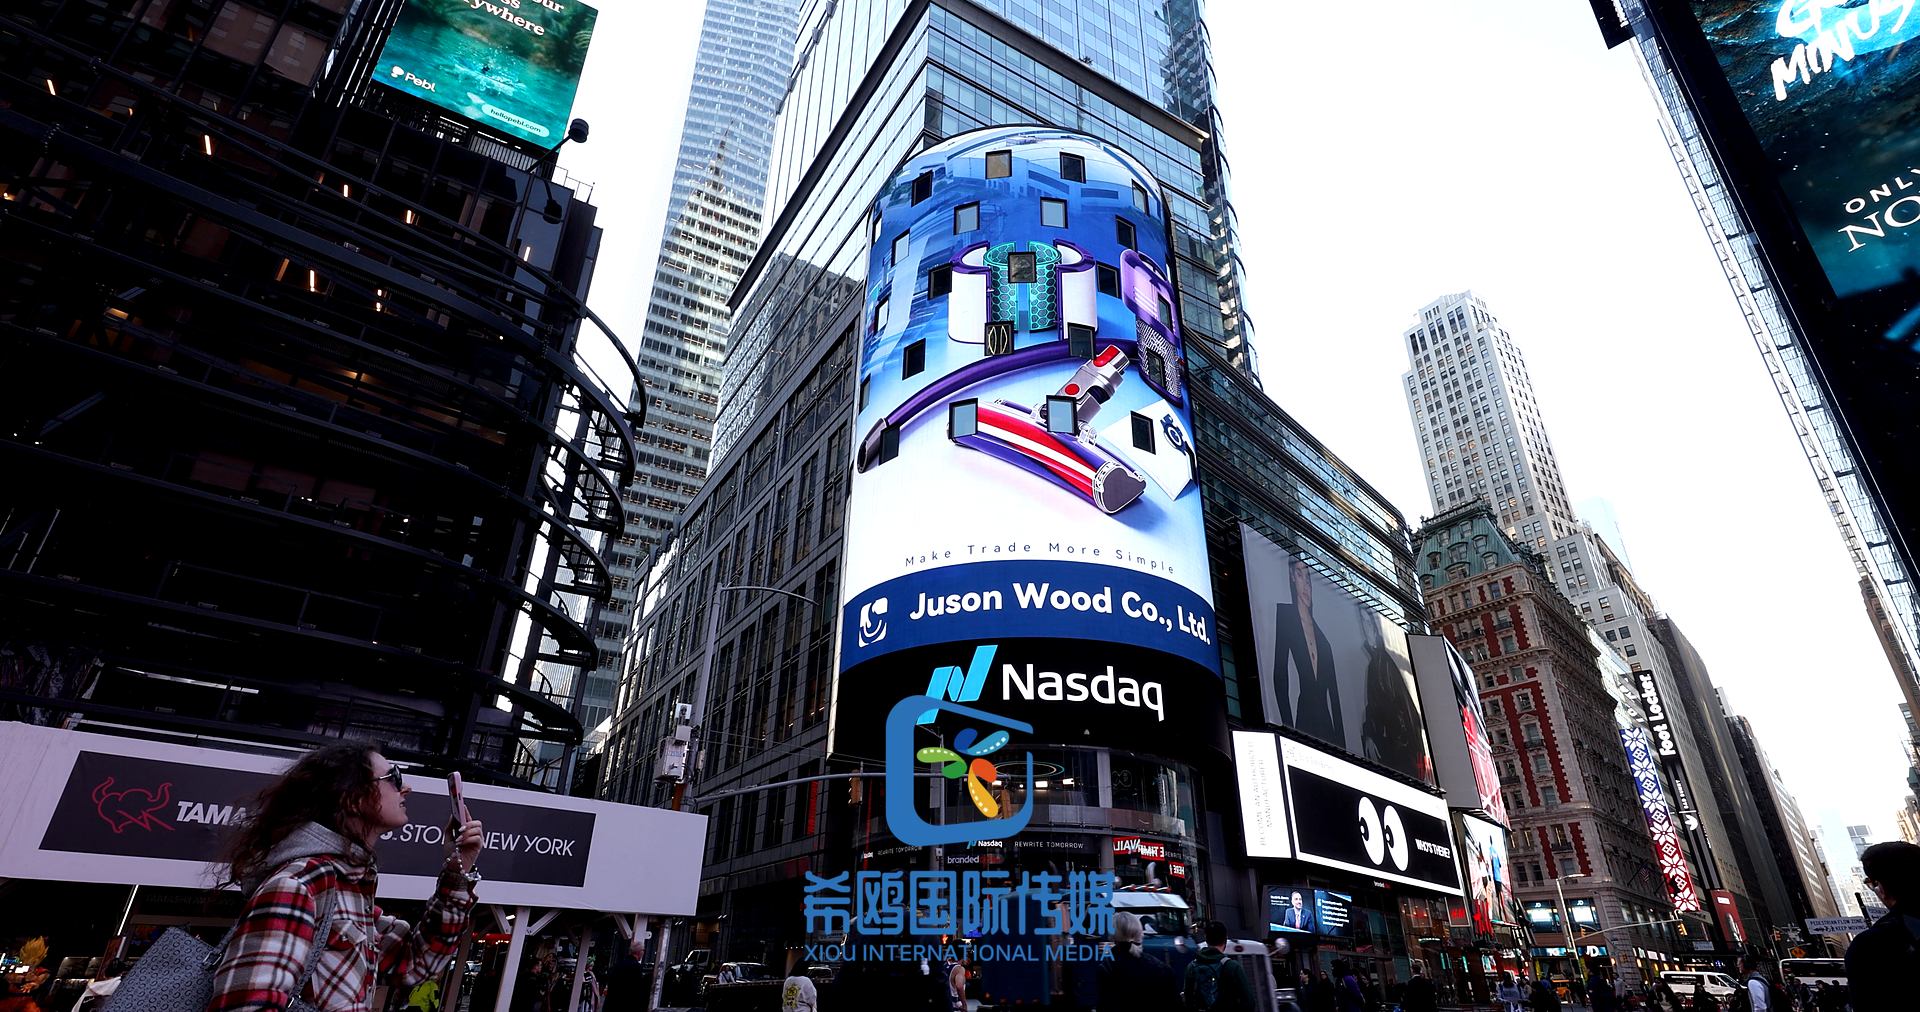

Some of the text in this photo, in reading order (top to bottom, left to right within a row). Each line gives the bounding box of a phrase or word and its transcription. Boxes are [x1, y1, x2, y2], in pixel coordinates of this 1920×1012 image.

[463, 0, 545, 36] ywhere
[405, 72, 436, 93] Pebl
[490, 108, 541, 133] hellopebl.com
[1845, 168, 1920, 214] ONL
[905, 542, 1174, 574] Make Trade More Simple
[909, 582, 1211, 645] Juson Wood Co., Ltd.
[1002, 663, 1165, 722] Nasdaq
[1640, 673, 1676, 756] Foot Locker
[176, 800, 252, 827] TAMA
[400, 823, 446, 845] STO
[524, 835, 576, 857] YORK
[978, 840, 1003, 848] Nasdaq
[947, 855, 980, 864] branded
[1586, 945, 1600, 958] JD
